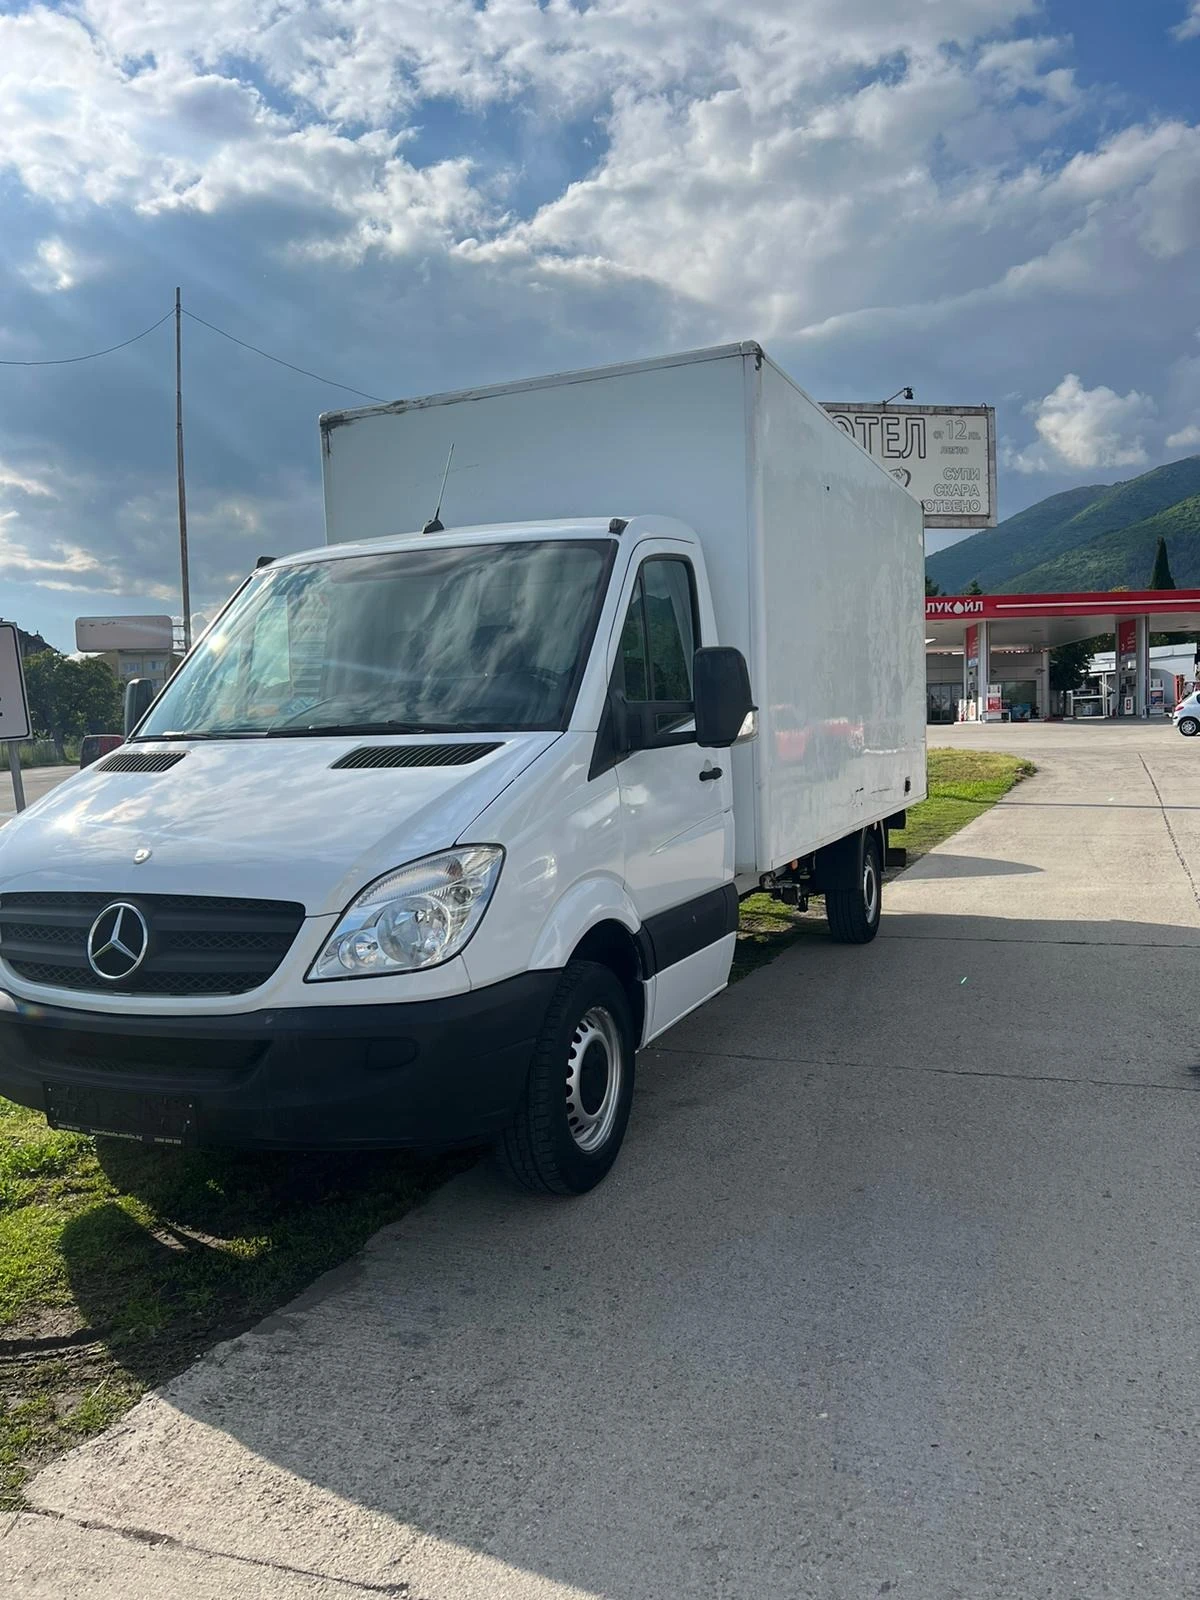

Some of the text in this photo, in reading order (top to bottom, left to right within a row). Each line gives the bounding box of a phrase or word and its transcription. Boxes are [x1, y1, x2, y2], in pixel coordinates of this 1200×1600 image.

[945, 419, 968, 440] 12
[943, 467, 981, 481] СУПИ
[933, 483, 980, 497] СКАРА
[923, 499, 981, 513] ОТВЕНО
